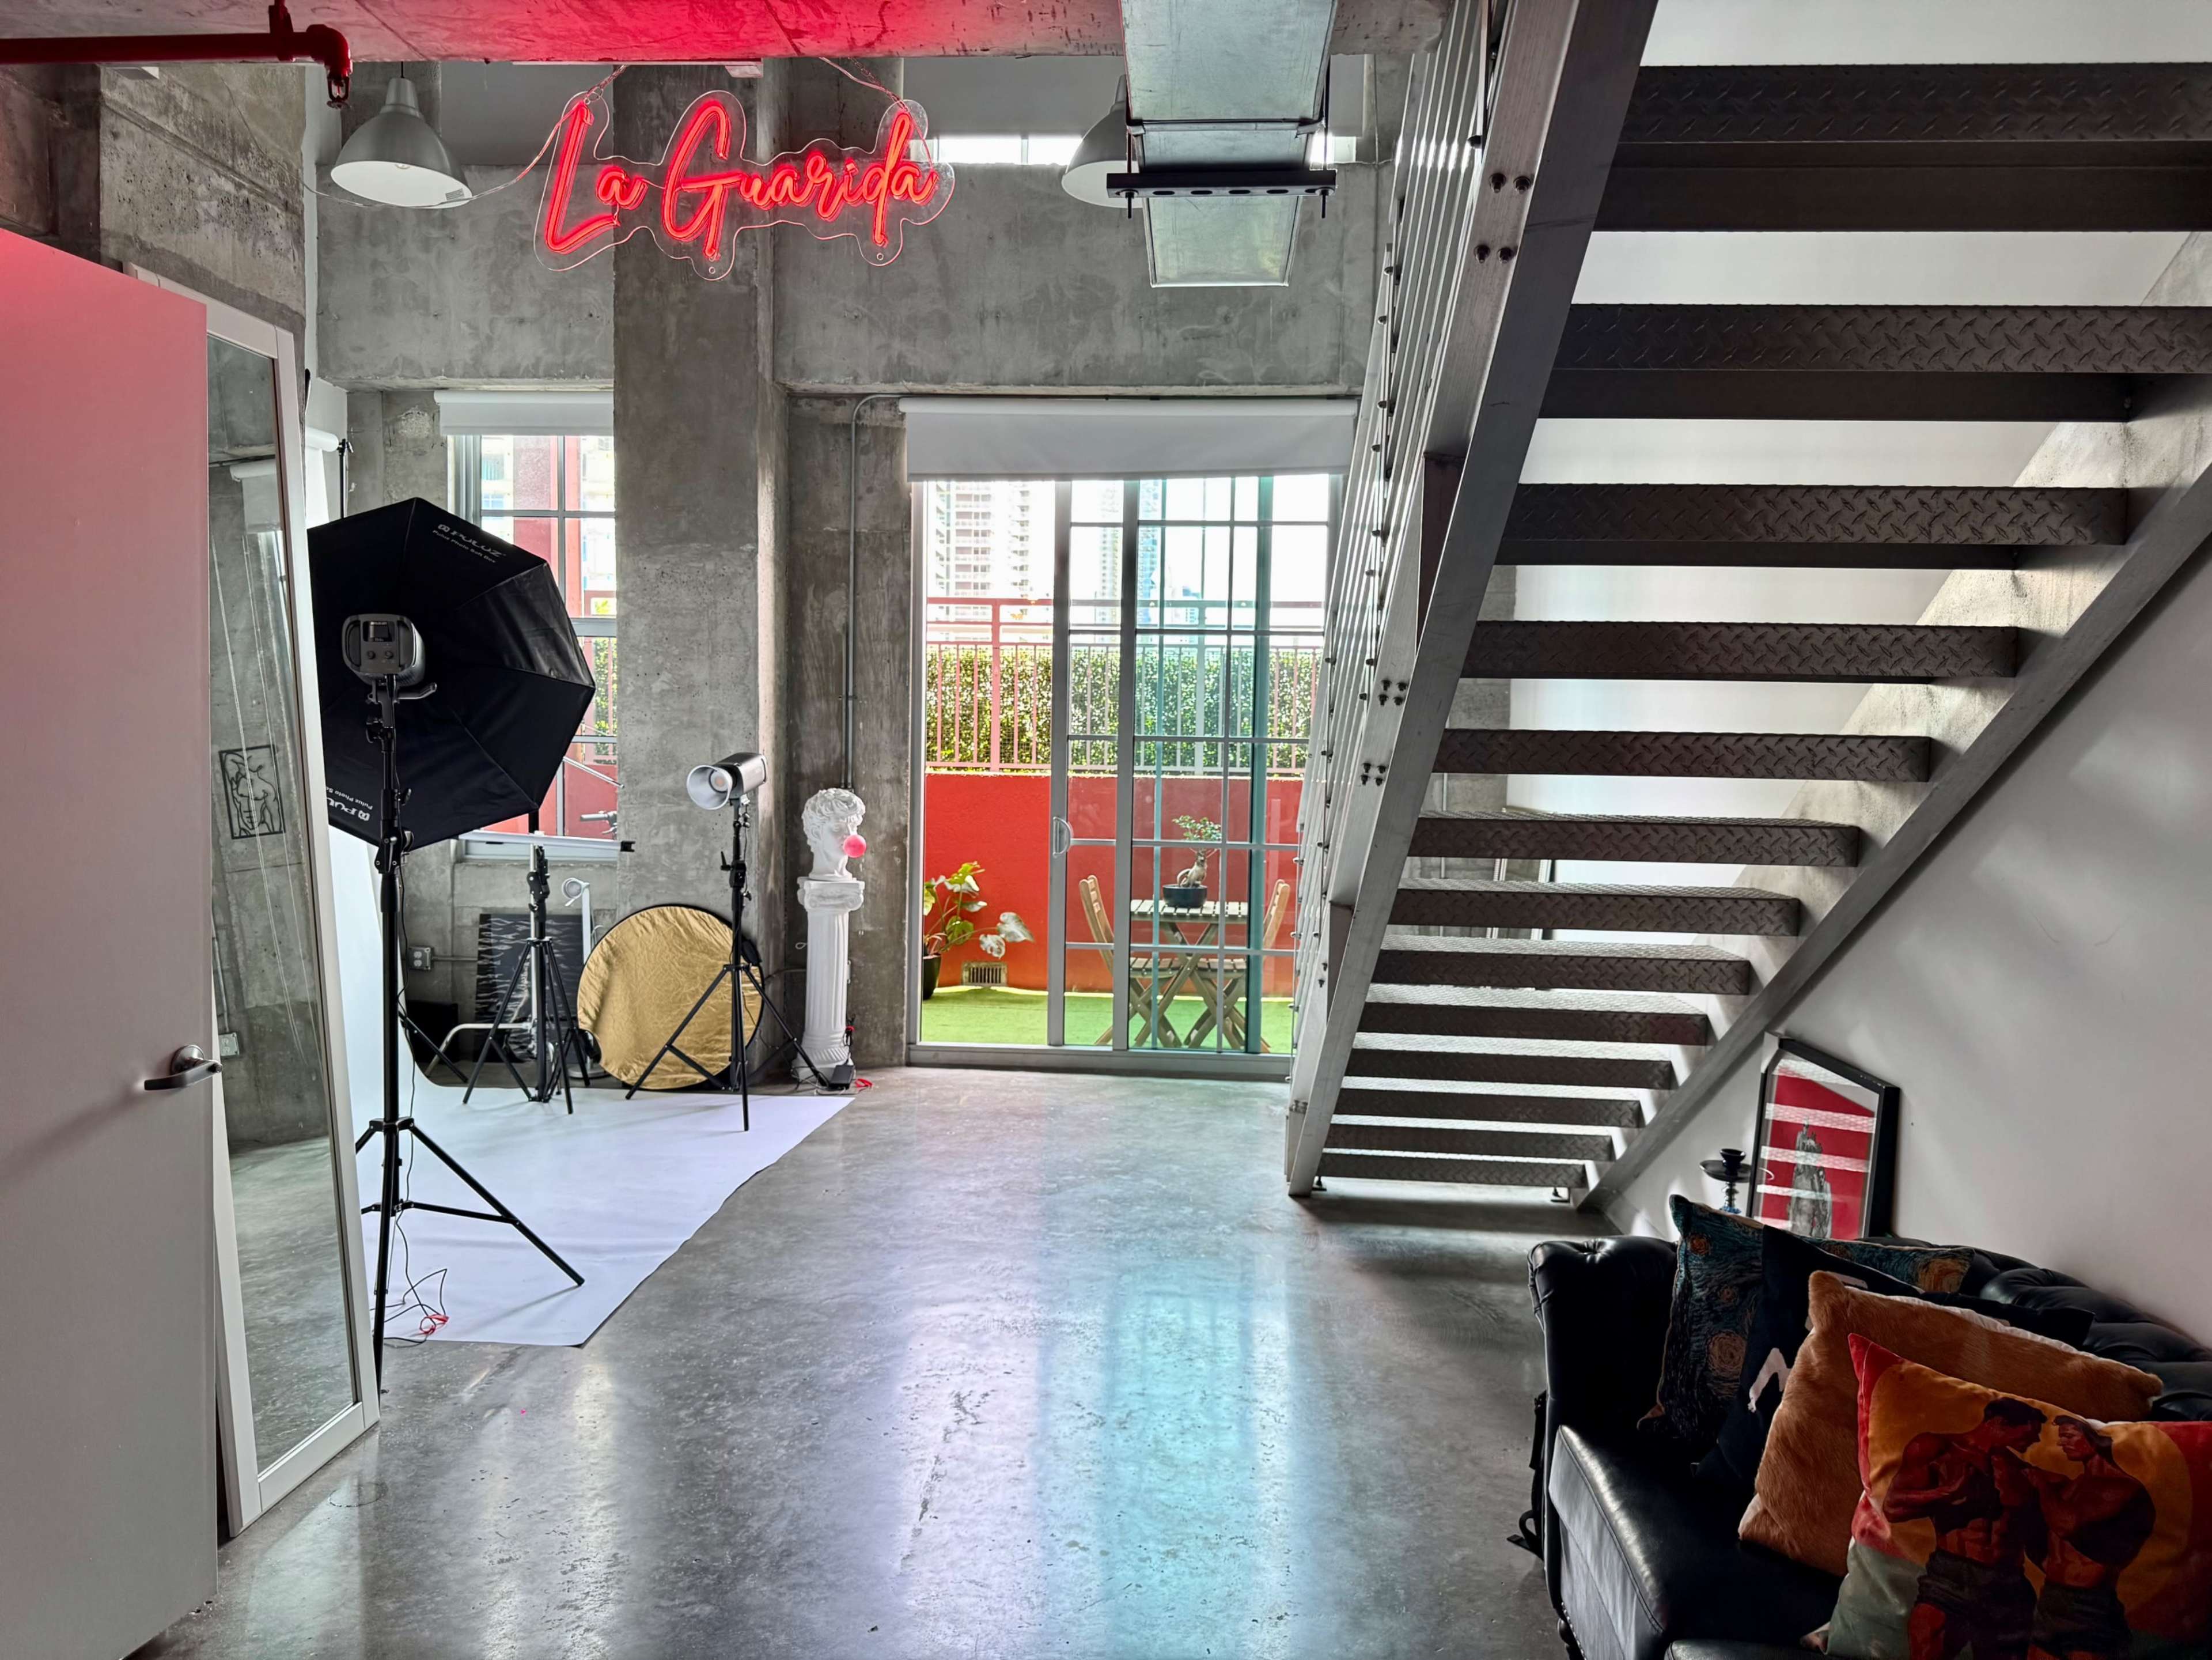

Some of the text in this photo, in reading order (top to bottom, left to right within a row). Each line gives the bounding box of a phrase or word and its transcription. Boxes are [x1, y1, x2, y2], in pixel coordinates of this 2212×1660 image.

[545, 99, 938, 260] La Guarida
[450, 531, 502, 557] PULUZ
[335, 791, 354, 801] Photo
